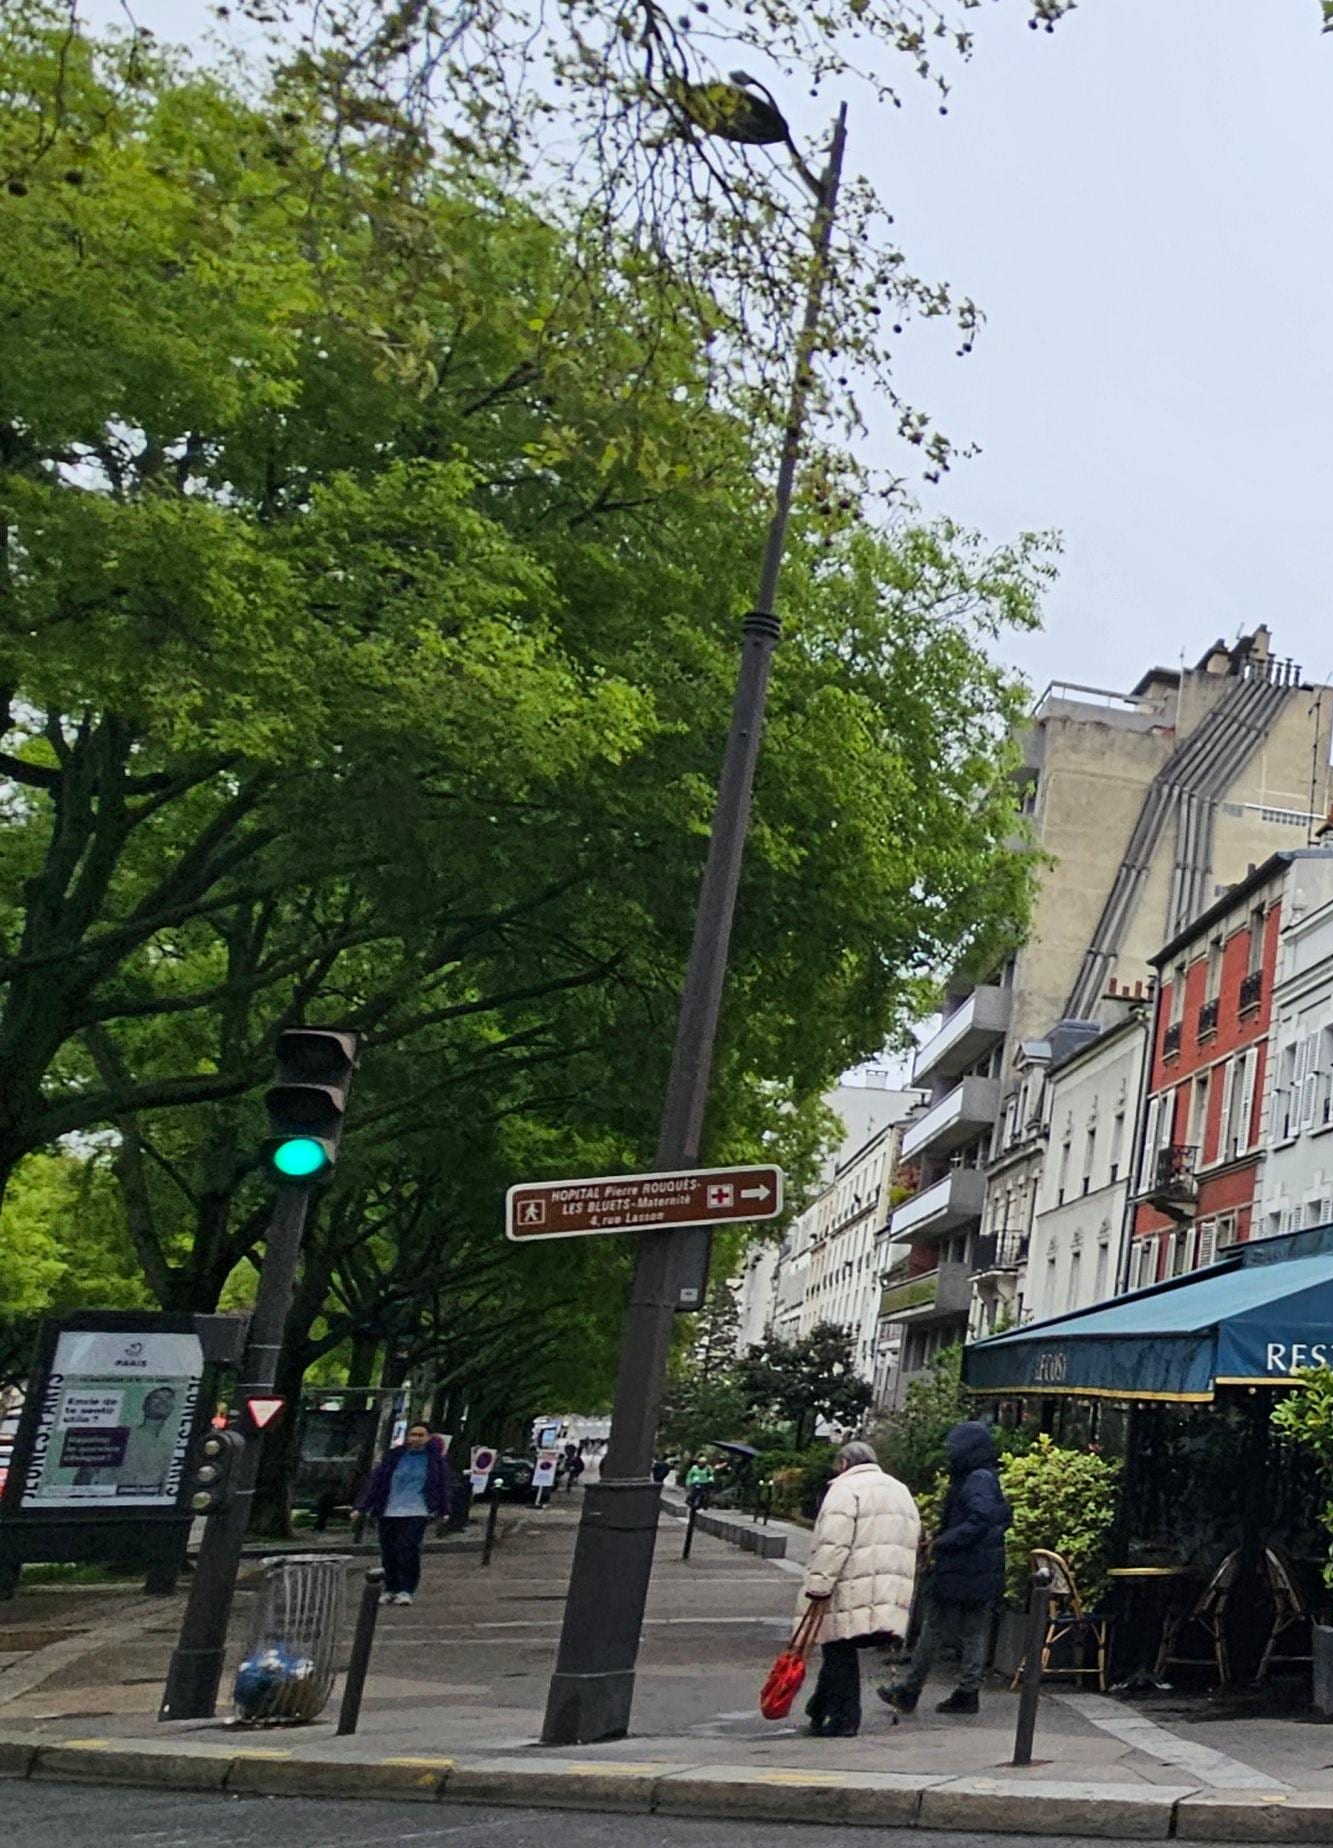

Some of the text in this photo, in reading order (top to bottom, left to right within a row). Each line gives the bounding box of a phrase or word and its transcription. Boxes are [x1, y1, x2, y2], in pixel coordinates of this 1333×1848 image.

[604, 1186, 639, 1198] Pierre
[562, 1202, 584, 1215] LES
[602, 1215, 622, 1225] rue
[625, 1211, 665, 1224] Lasson
